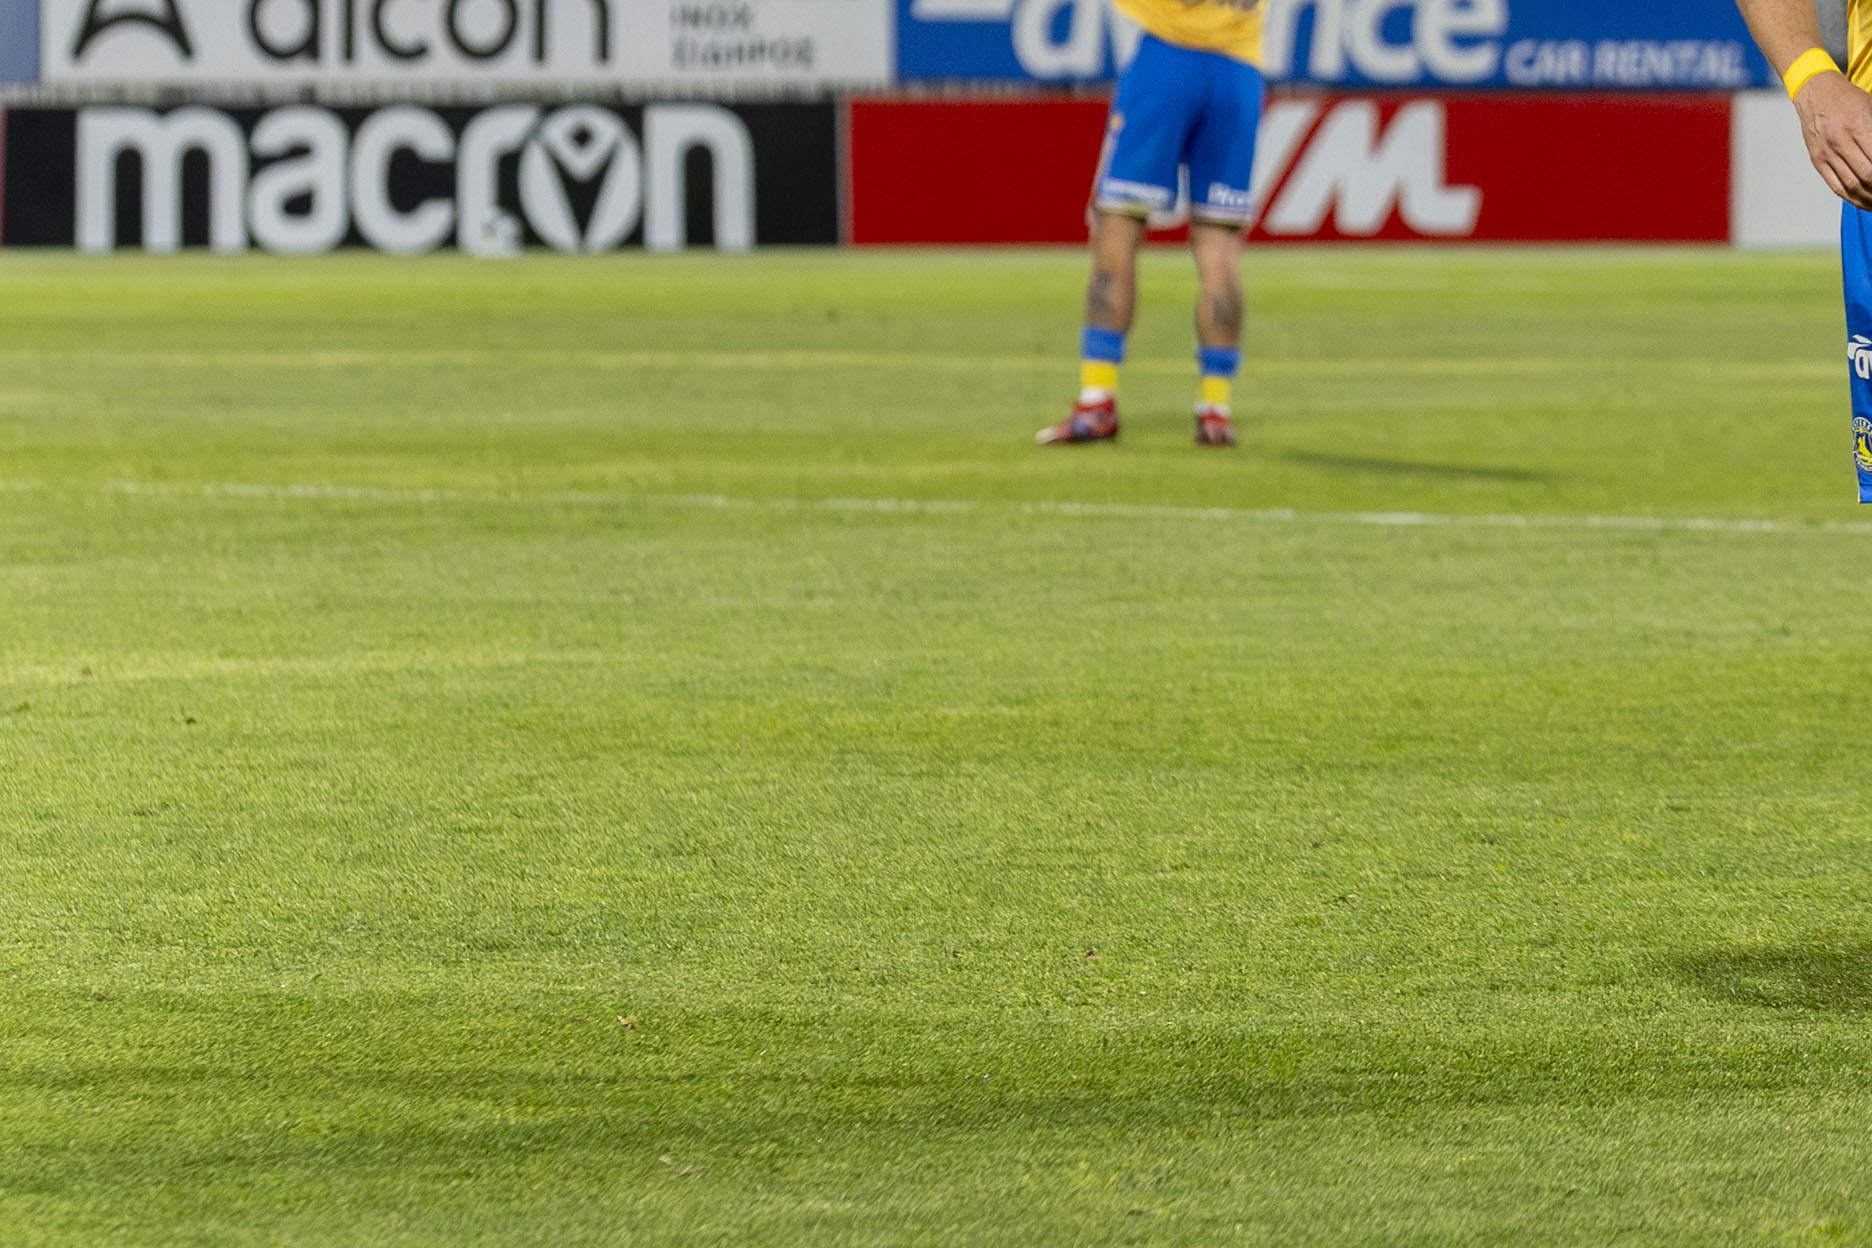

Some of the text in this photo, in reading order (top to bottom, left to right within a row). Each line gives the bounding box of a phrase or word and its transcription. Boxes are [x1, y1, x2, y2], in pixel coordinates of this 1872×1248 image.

[1504, 40, 1744, 86] CAR RENTAL
[74, 103, 758, 255] macron
